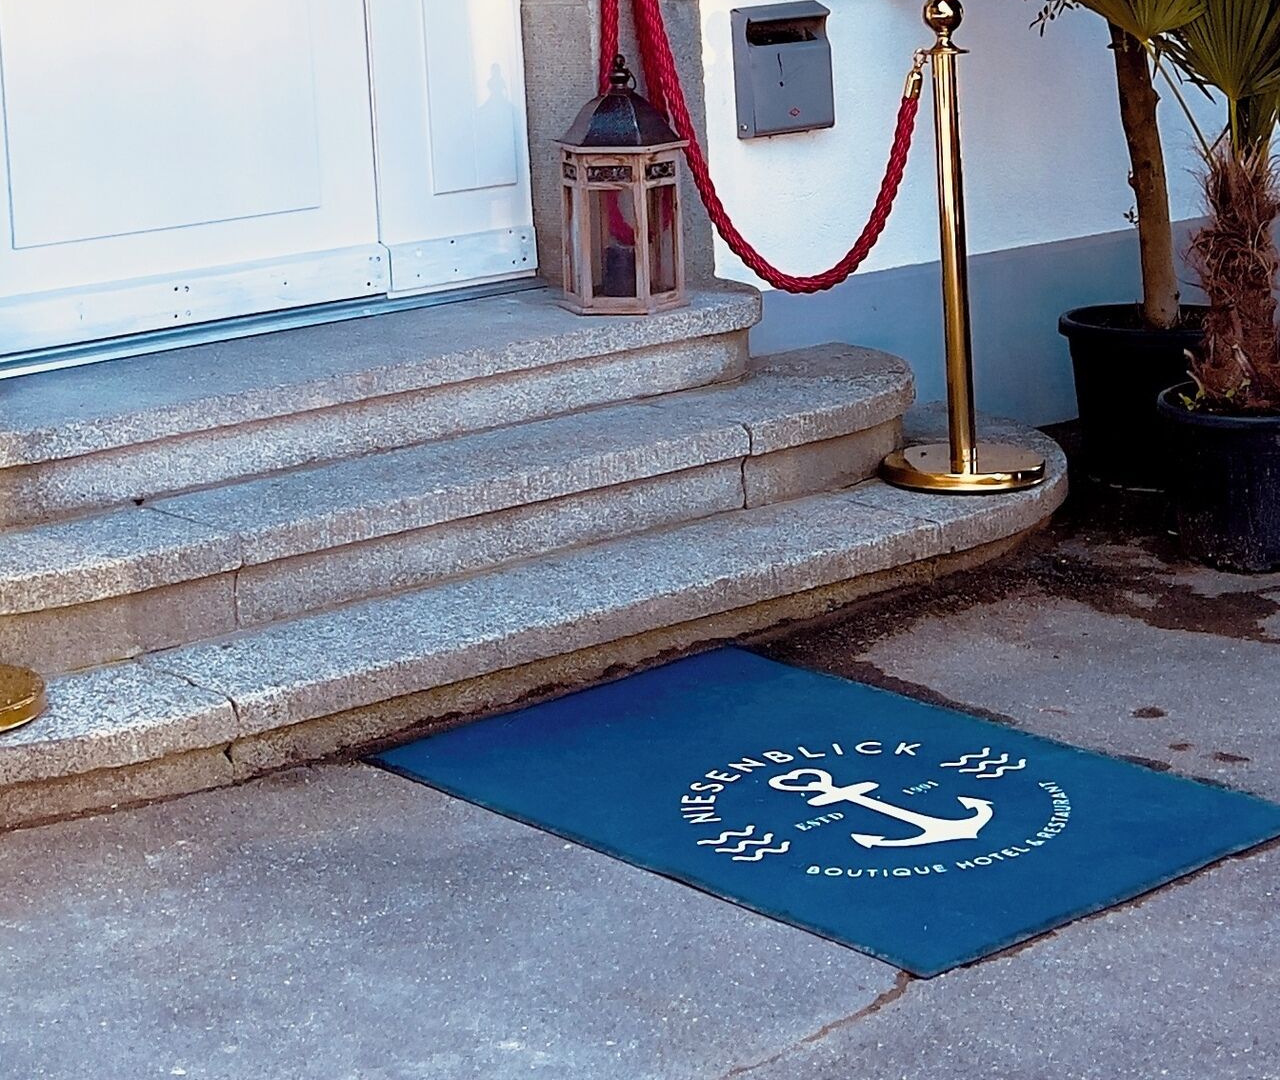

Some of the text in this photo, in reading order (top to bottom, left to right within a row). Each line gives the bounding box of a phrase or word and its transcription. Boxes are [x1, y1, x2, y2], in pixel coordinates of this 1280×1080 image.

[680, 741, 921, 824] NIESENBLICK
[806, 781, 1072, 878] BOUTIQUE HOTEL & RESTAURANT
